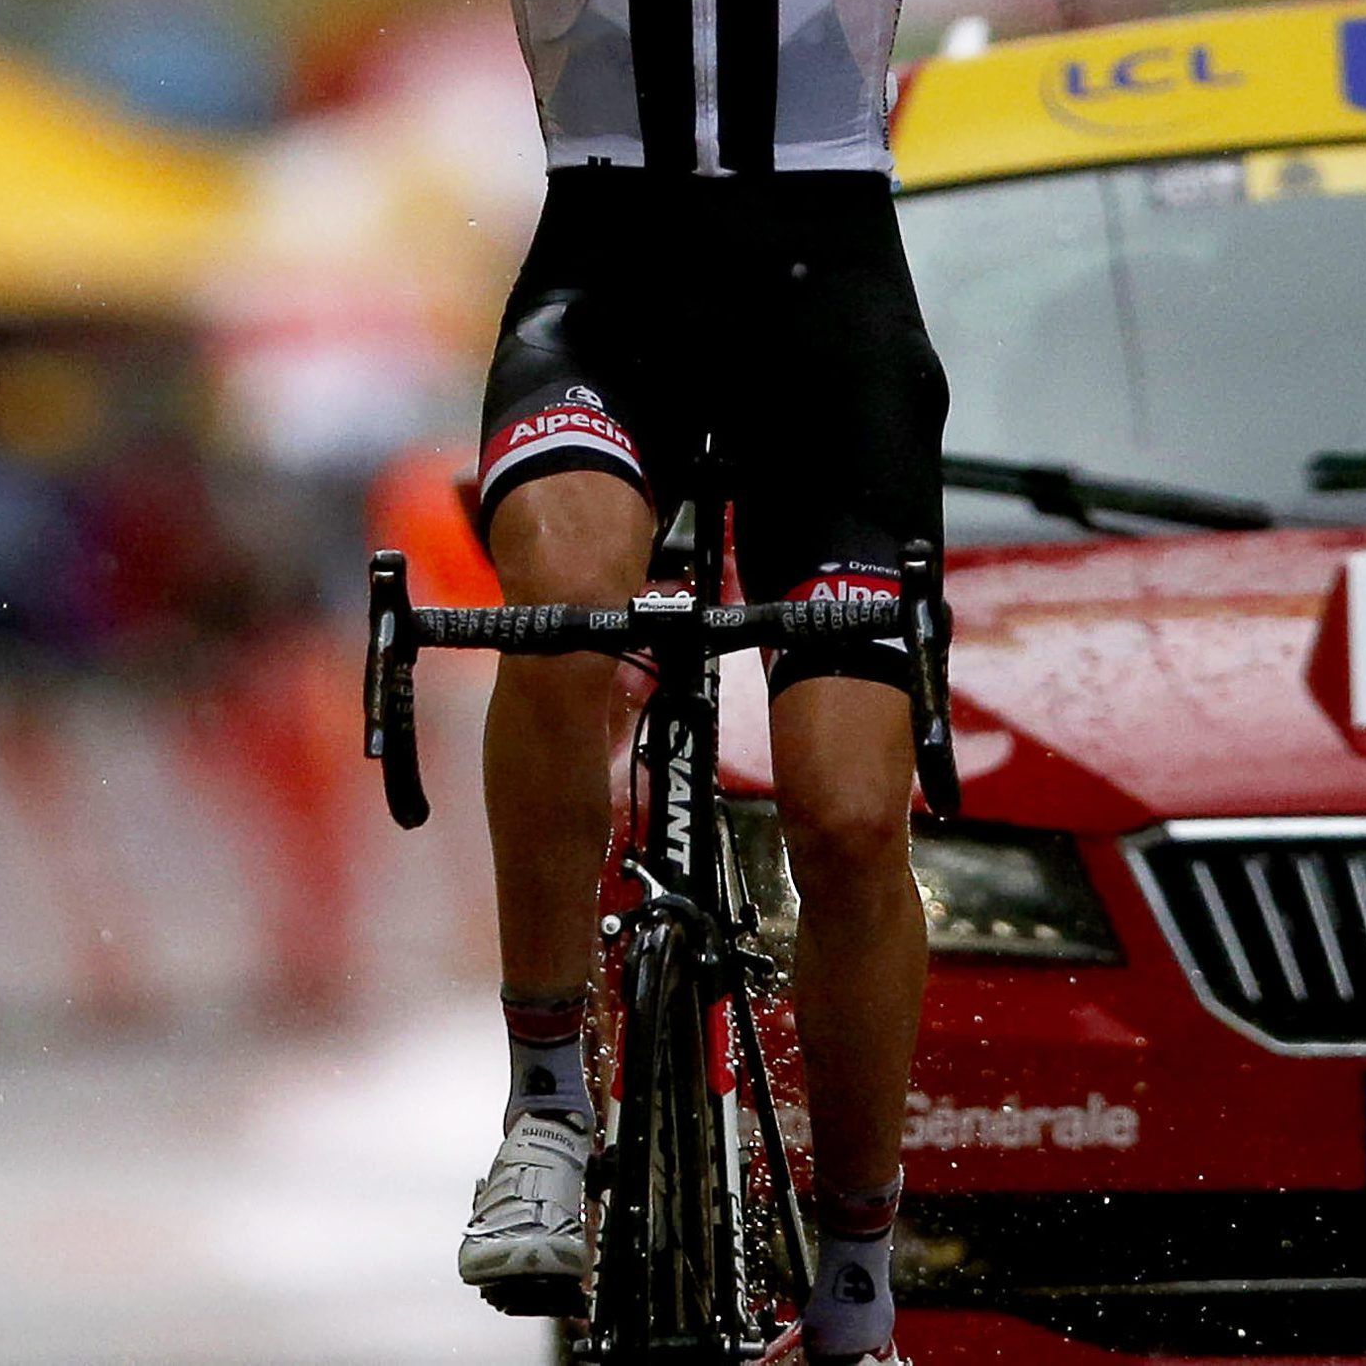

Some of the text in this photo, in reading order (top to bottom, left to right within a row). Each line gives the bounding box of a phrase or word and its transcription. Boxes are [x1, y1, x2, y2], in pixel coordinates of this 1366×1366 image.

[1062, 45, 1247, 100] LCL
[508, 412, 632, 451] Alpecin
[638, 602, 690, 610] Pioneer
[809, 580, 900, 603] Alpe
[666, 720, 694, 875] GIANT
